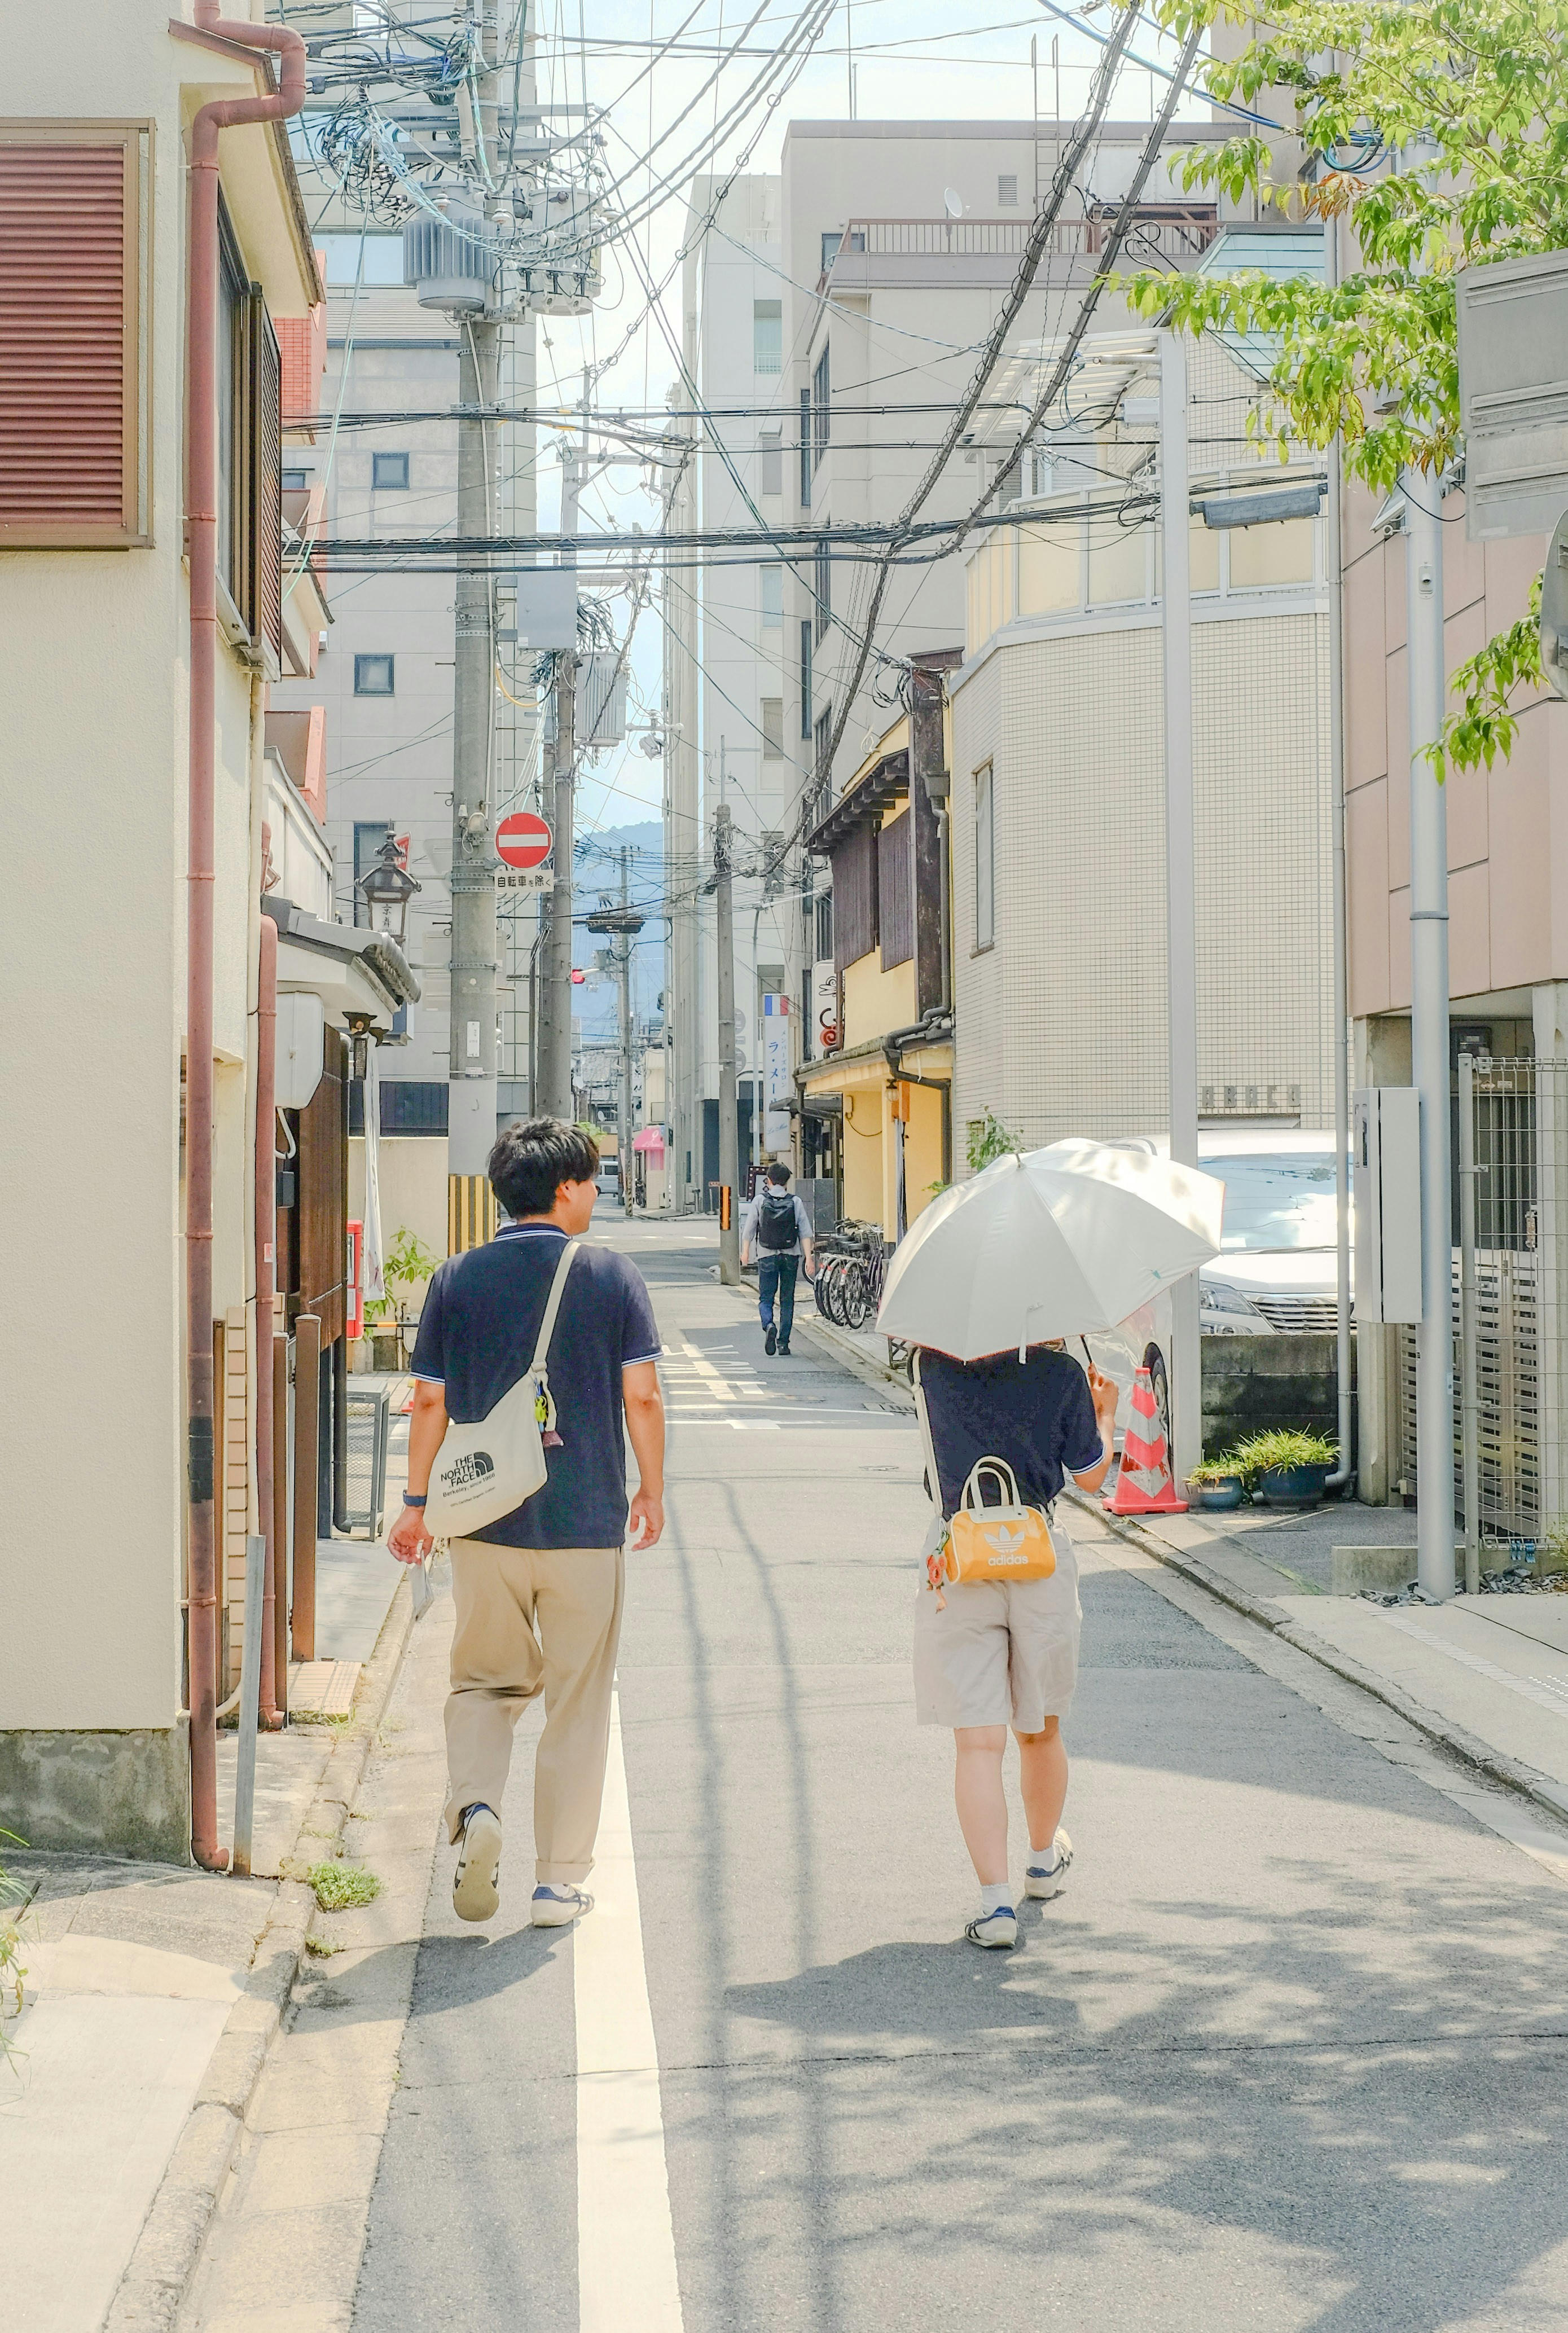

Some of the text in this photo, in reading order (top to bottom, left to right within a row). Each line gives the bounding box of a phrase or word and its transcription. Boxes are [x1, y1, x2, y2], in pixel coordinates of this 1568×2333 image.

[498, 875, 551, 887] 自転車を除く
[768, 1042, 779, 1103] ラ・メー
[1202, 1084, 1301, 1108] ABACO
[454, 1454, 473, 1468] THE
[441, 1462, 474, 1482] NORTH
[451, 1471, 475, 1487] FACE
[443, 1486, 469, 1497] Berkeley,
[988, 1554, 1029, 1566] adidas
